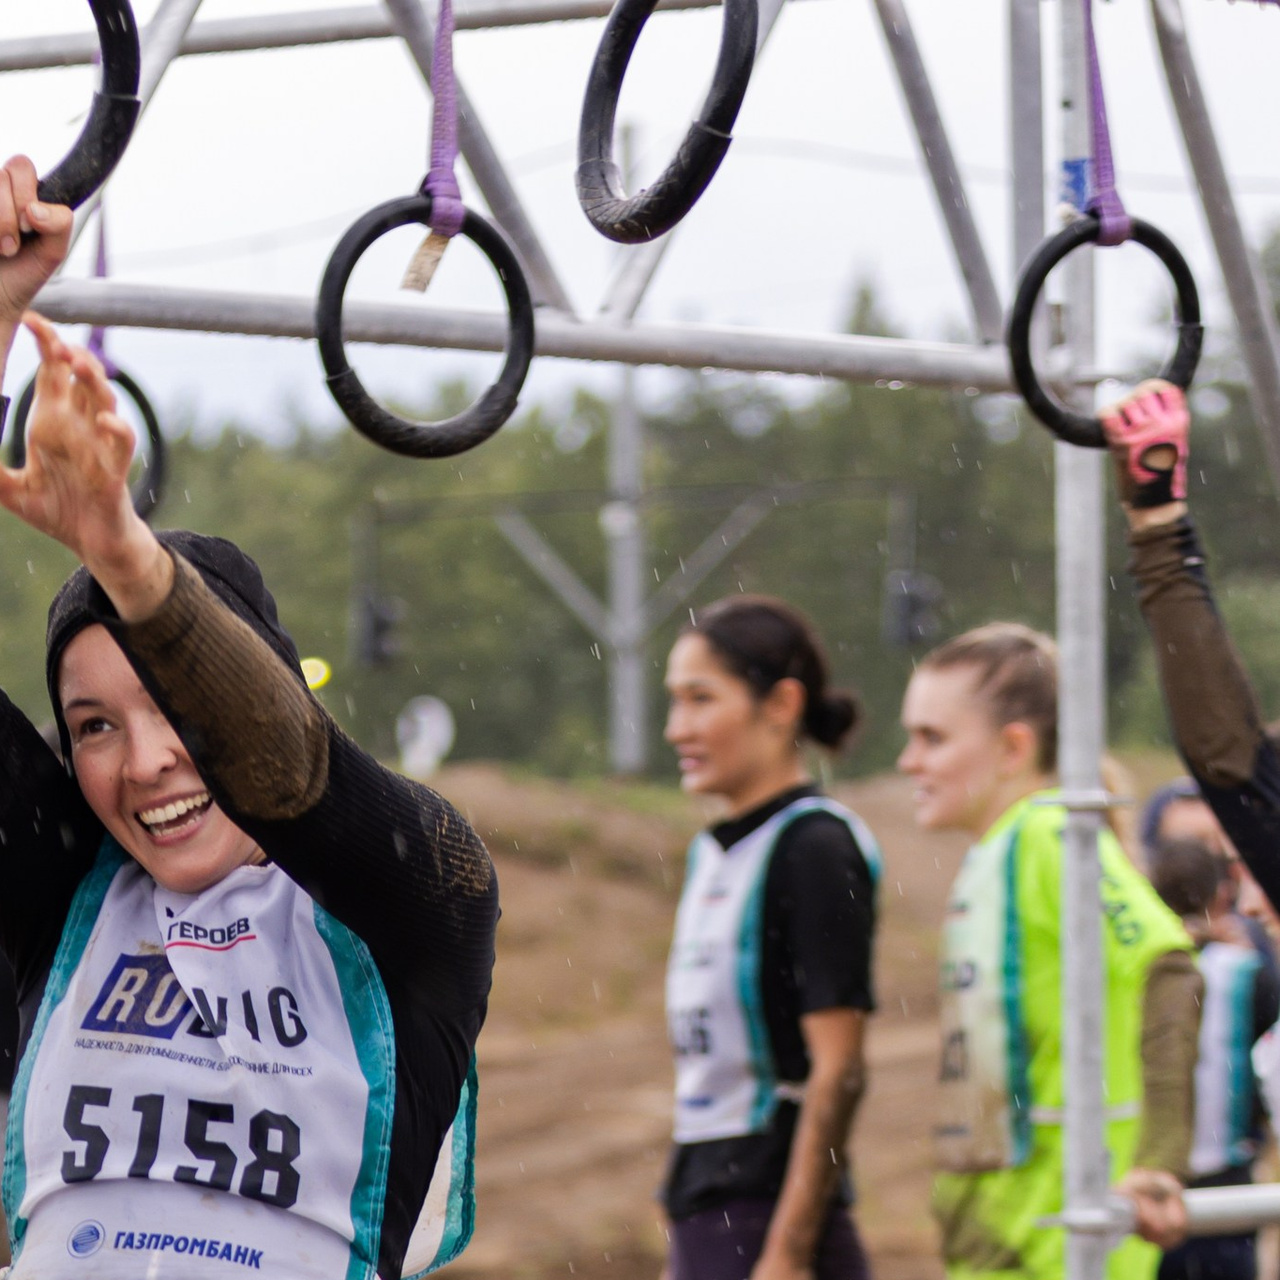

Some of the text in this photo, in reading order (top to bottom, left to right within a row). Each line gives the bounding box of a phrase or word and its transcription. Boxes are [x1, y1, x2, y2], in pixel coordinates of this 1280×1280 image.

[167, 917, 251, 945] ГЕРОЕВ
[60, 1085, 301, 1209] 5158
[114, 1231, 263, 1269] ГАЗПРОМБАНК
